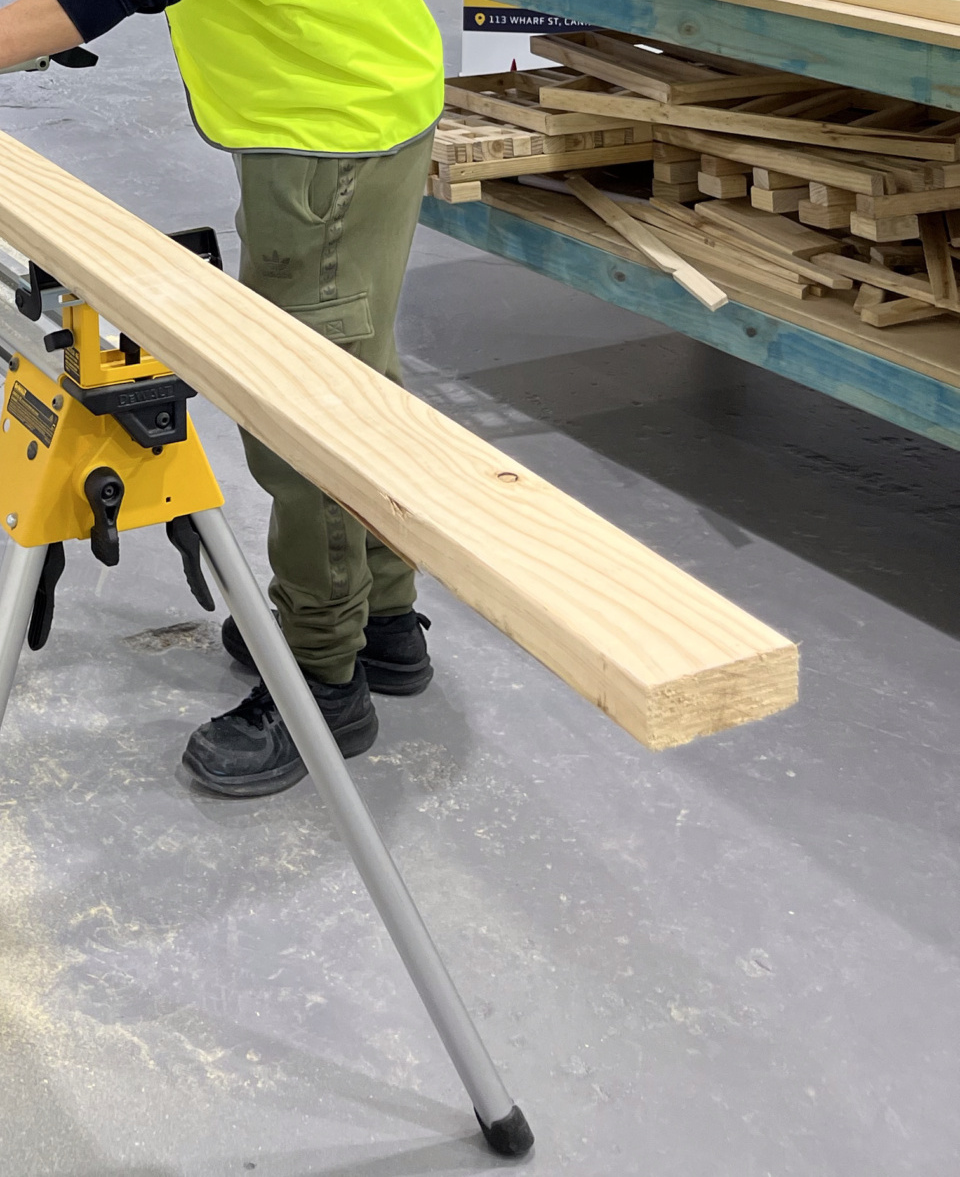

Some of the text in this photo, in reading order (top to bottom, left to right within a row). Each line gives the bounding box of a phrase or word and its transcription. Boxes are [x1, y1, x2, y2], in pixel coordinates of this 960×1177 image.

[489, 15, 506, 24] 113
[509, 16, 545, 25] WHARF
[547, 17, 562, 27] ST,
